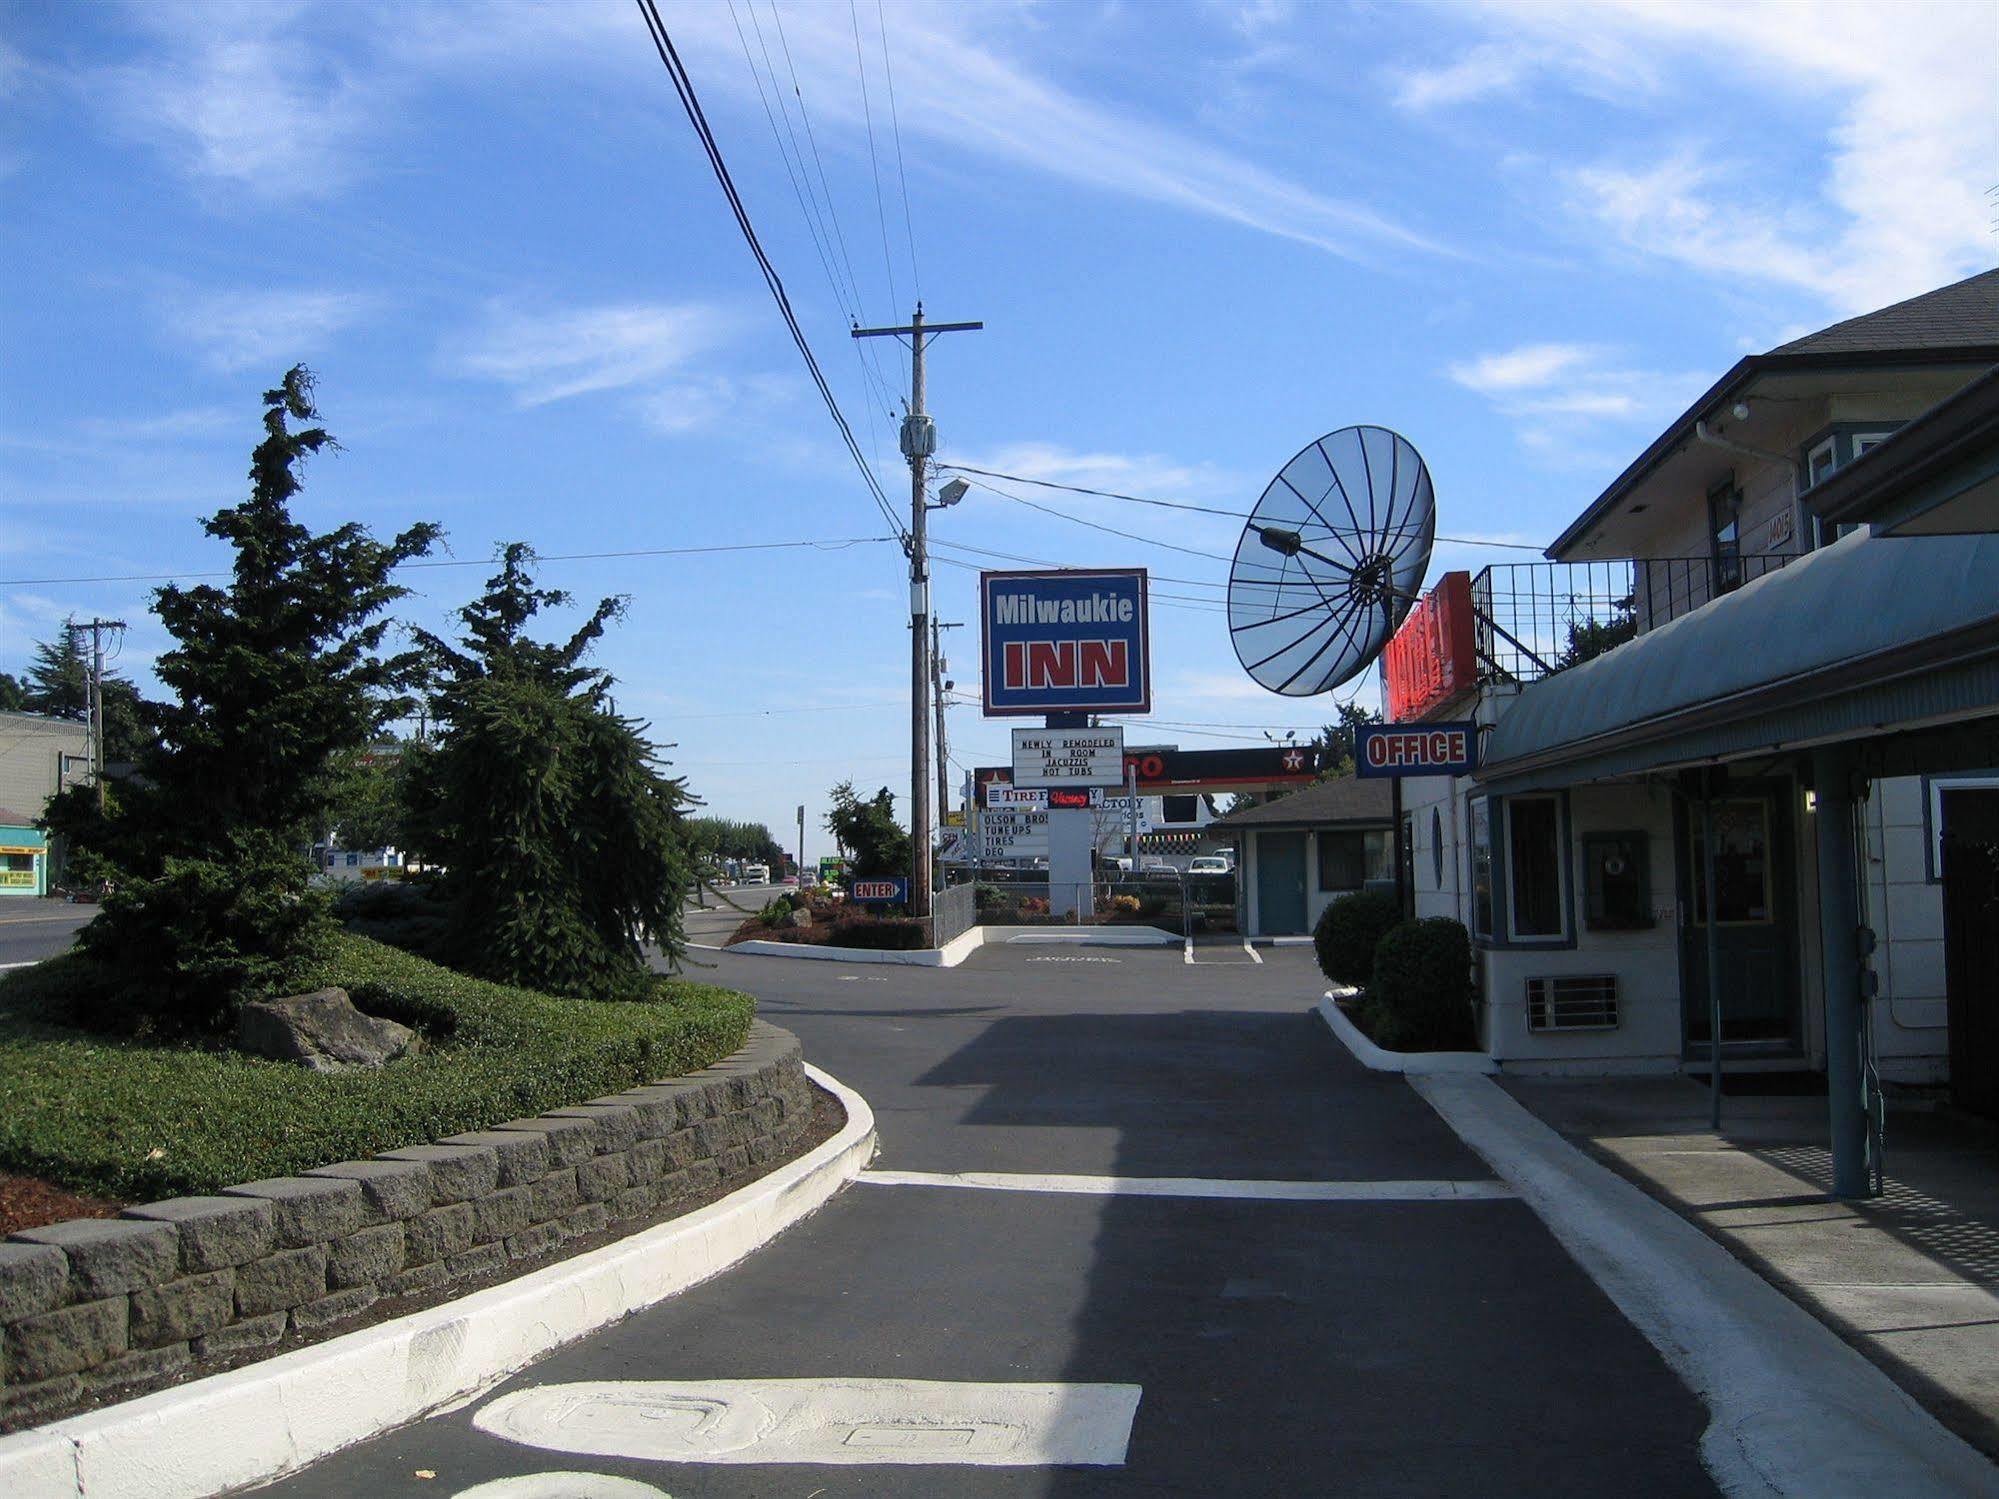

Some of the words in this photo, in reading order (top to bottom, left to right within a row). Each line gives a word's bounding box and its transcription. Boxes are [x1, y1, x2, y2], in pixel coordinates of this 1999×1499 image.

[996, 593, 1133, 625] Milwaukie
[1003, 639, 1129, 690] INN
[1022, 740, 1052, 749] NEWLY
[1062, 739, 1115, 748] REMODELED
[1367, 731, 1466, 767] OFFICE
[1042, 750, 1051, 758] IN
[1070, 749, 1096, 758] ROOM
[1045, 759, 1088, 767] JACUZZIS
[1043, 768, 1059, 776] HOT
[1069, 767, 1092, 776] TUBS
[1003, 790, 1037, 801] TIRE
[985, 836, 1014, 846] TIRES
[854, 882, 894, 898] ENTER
